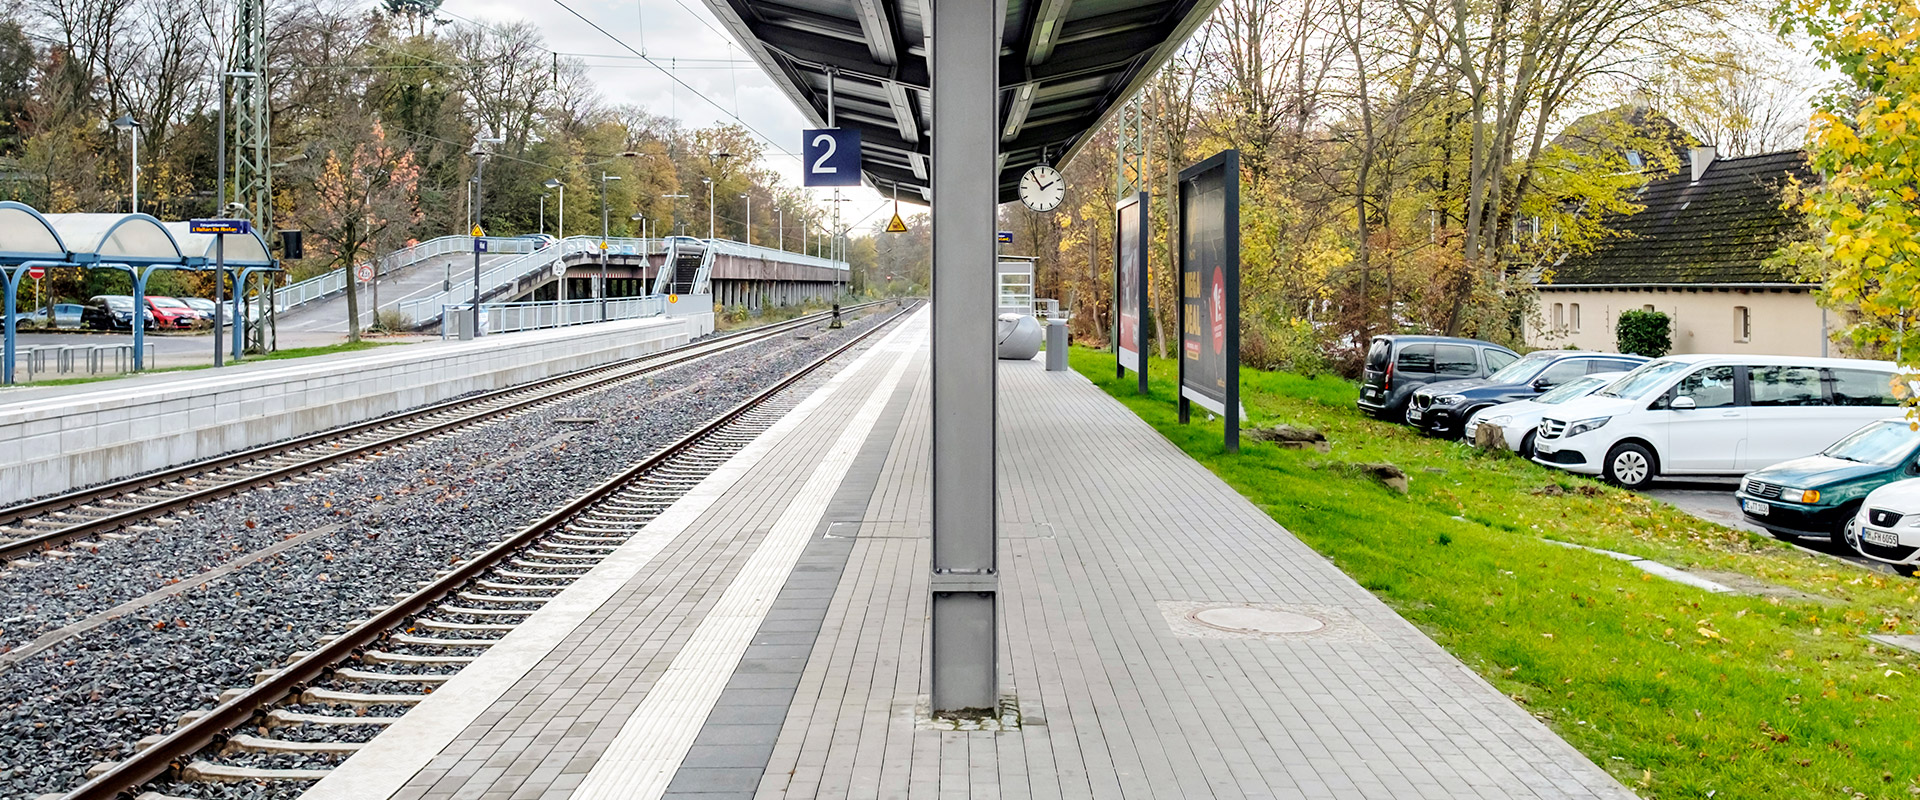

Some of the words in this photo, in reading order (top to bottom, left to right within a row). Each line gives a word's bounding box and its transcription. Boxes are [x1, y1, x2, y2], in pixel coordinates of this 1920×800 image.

[812, 134, 837, 173] 2
[1185, 272, 1200, 298] MEGA
[1185, 304, 1200, 336] DEAL
[1882, 533, 1897, 545] 6055
